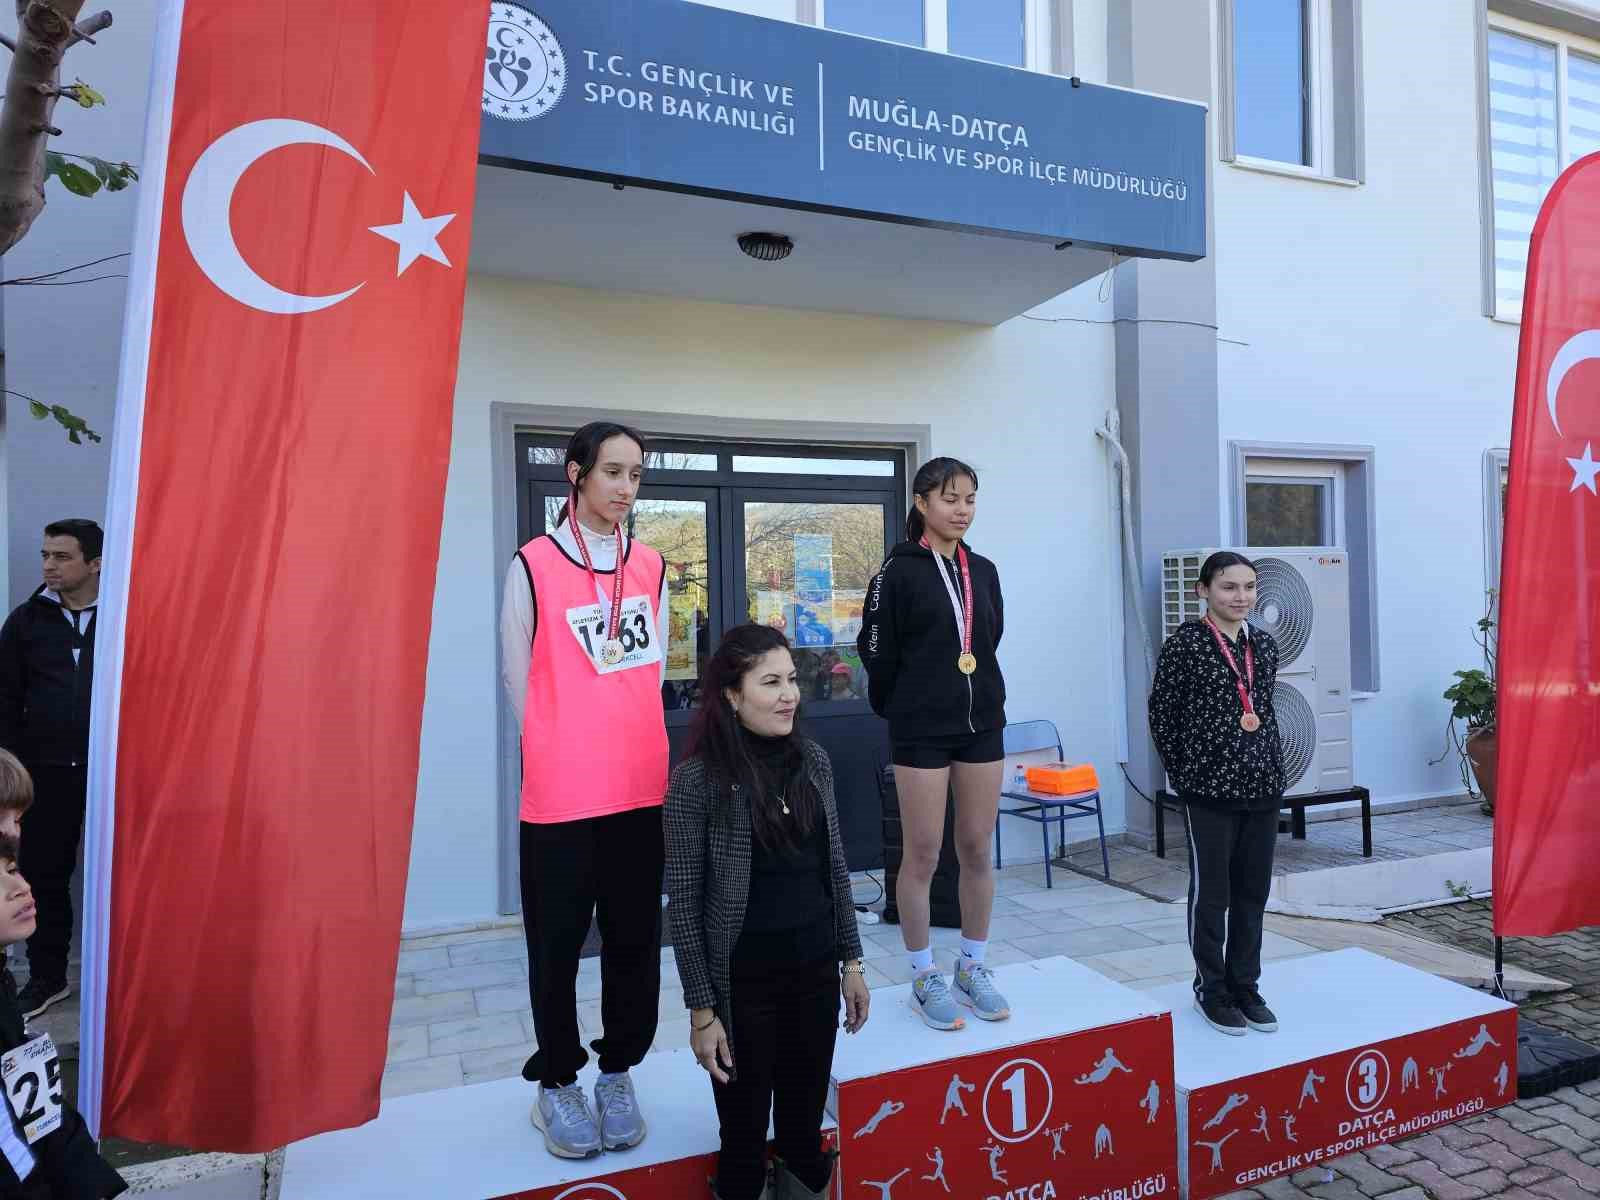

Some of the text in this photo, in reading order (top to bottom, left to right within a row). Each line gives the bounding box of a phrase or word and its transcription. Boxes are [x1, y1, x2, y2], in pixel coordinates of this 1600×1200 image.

[583, 50, 794, 106] T.C. GENÇLİK VE
[584, 82, 795, 137] SPOR BAKANLIĞI
[849, 95, 1029, 151] MUĞLA-DATÇA
[848, 131, 1187, 201] GENÇLİK VE SPOR İLÇE MÜDÜRLÜĞÜ
[578, 614, 650, 658] 163
[869, 573, 883, 652] Klein Calvin
[1002, 1068, 1027, 1133] 1
[1358, 1058, 1377, 1104] 3
[1235, 1096, 1484, 1185] GENÇLİK VE SPOR İLÇE MÜDÜRLÜĞÜ
[1338, 1108, 1396, 1137] DATÇA
